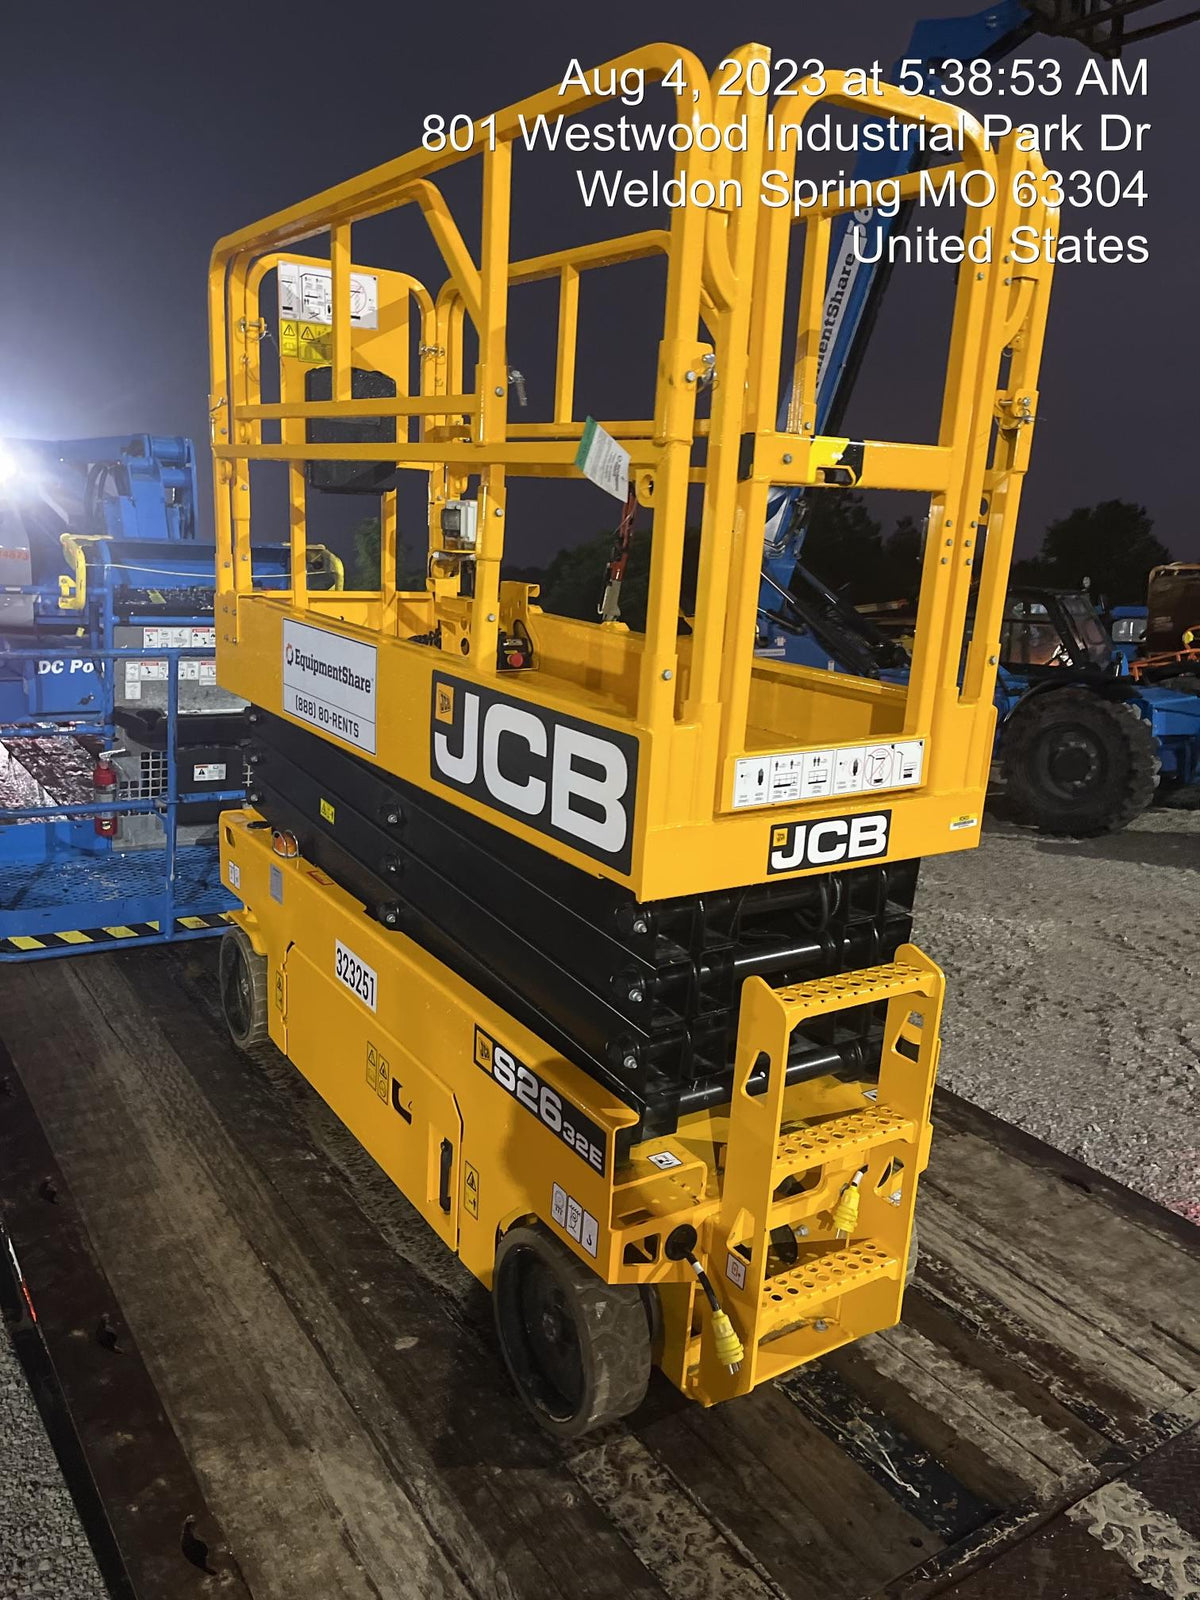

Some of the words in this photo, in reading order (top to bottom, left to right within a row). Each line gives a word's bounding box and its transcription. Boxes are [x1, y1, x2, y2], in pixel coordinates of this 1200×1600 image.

[38, 660, 64, 675] DC
[294, 648, 372, 694] EquipmentShare
[294, 694, 317, 723] (888)
[318, 702, 360, 739] 80-RENTS
[433, 692, 628, 853] JCB
[771, 814, 888, 870] JCB
[335, 946, 376, 1006] 323251
